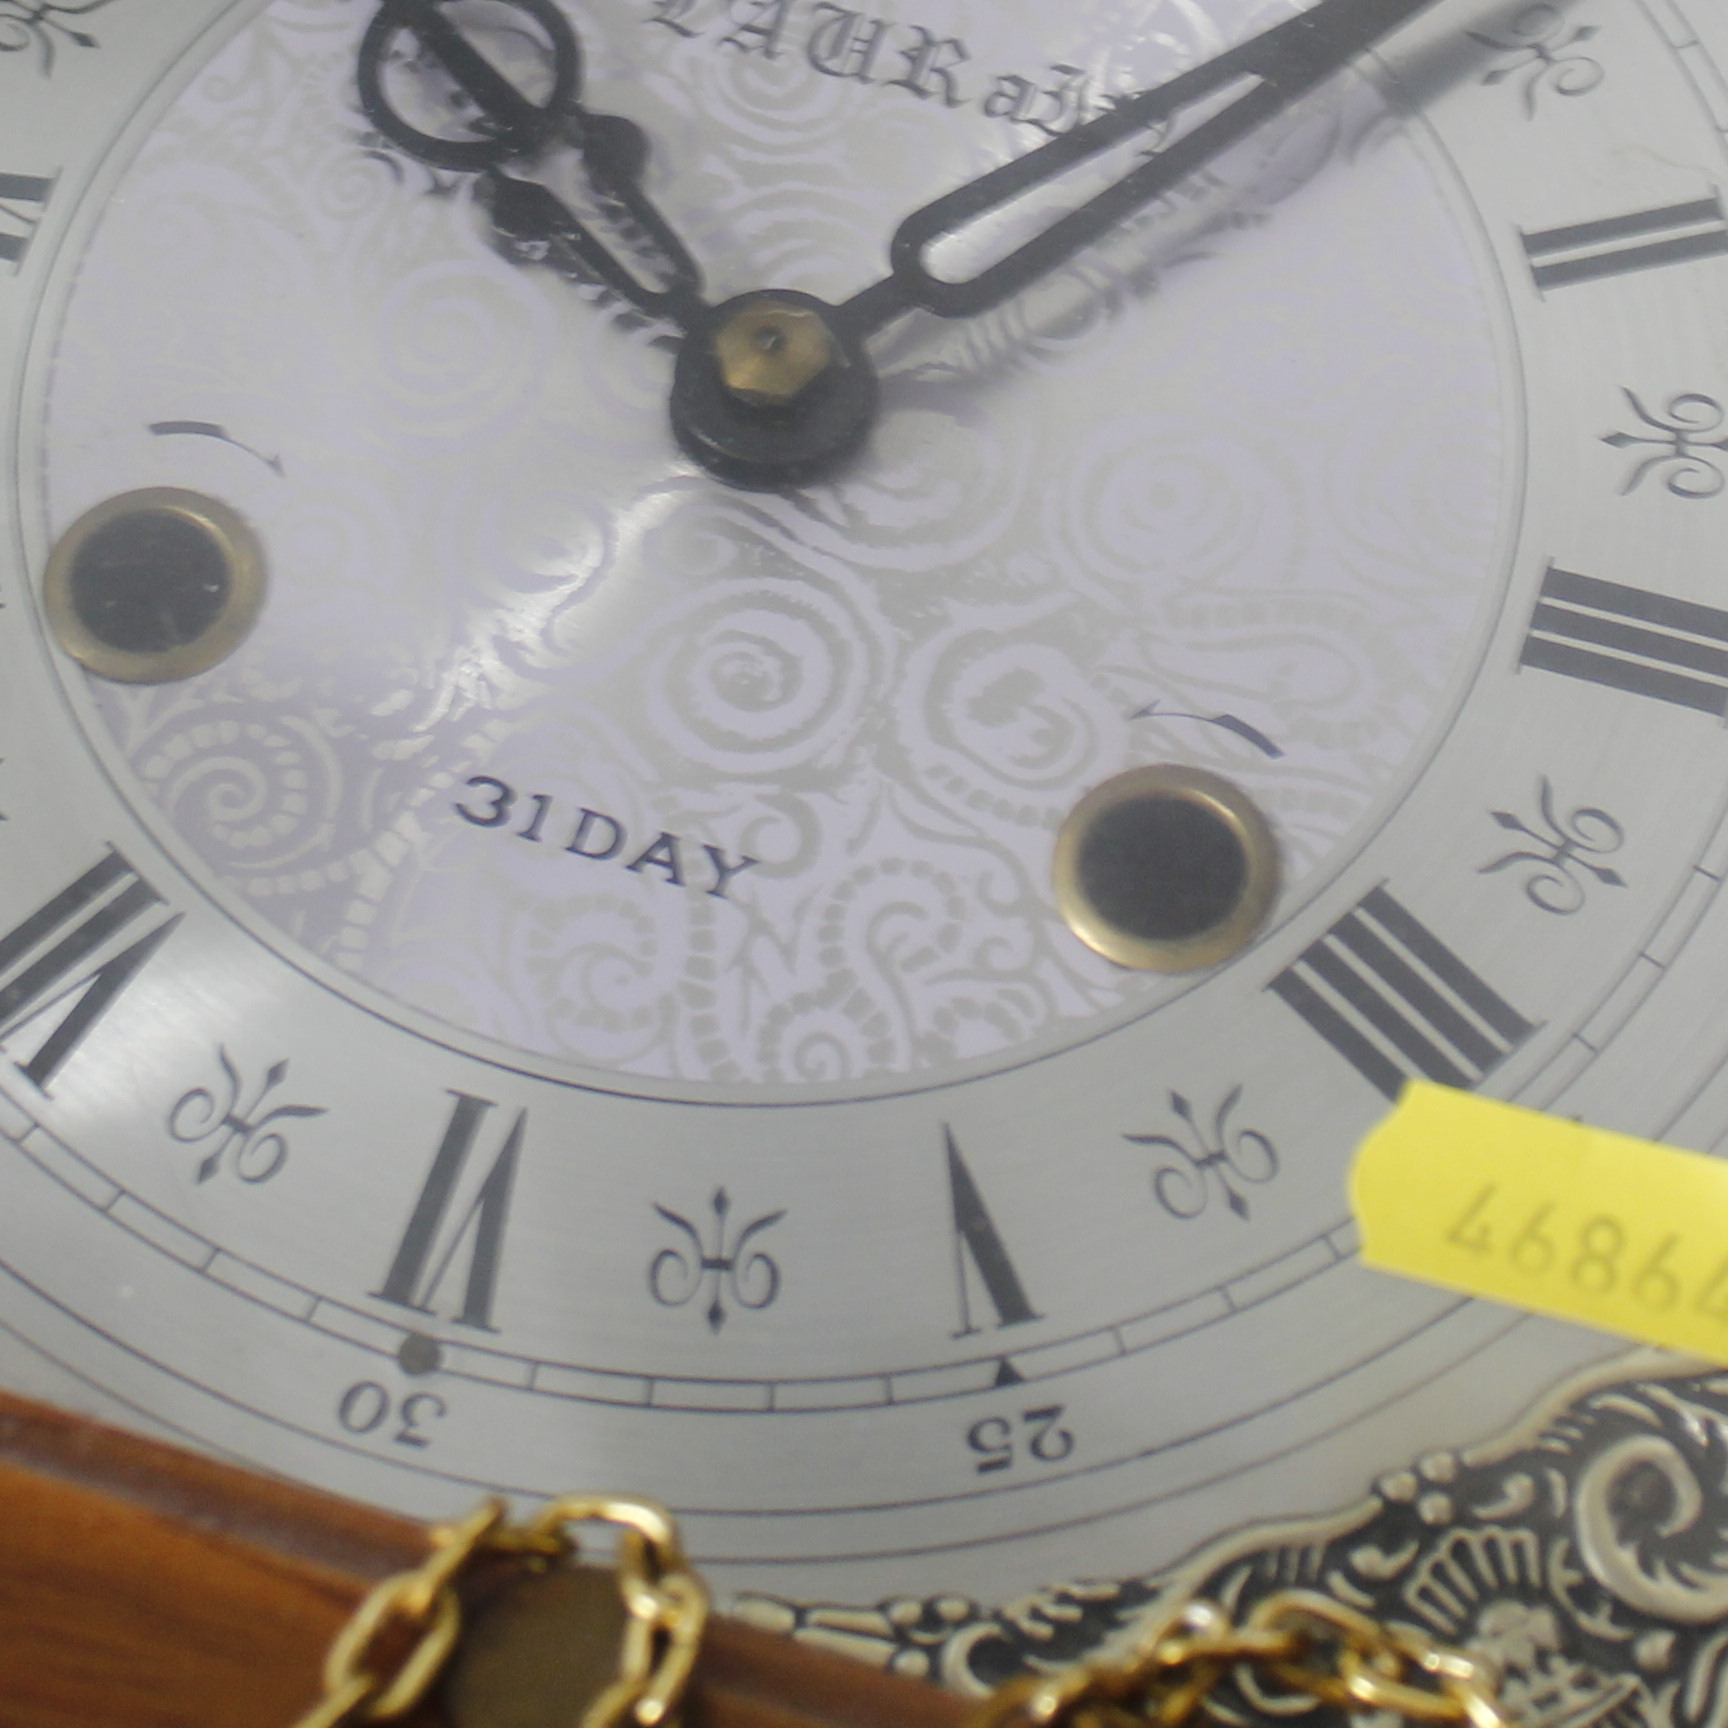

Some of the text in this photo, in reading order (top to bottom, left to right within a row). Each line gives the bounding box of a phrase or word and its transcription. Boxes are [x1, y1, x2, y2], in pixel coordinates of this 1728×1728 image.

[366, 1088, 529, 1334] VI
[942, 1121, 1045, 1339] V
[336, 1378, 449, 1450] 30
[966, 1402, 1075, 1474] 25
